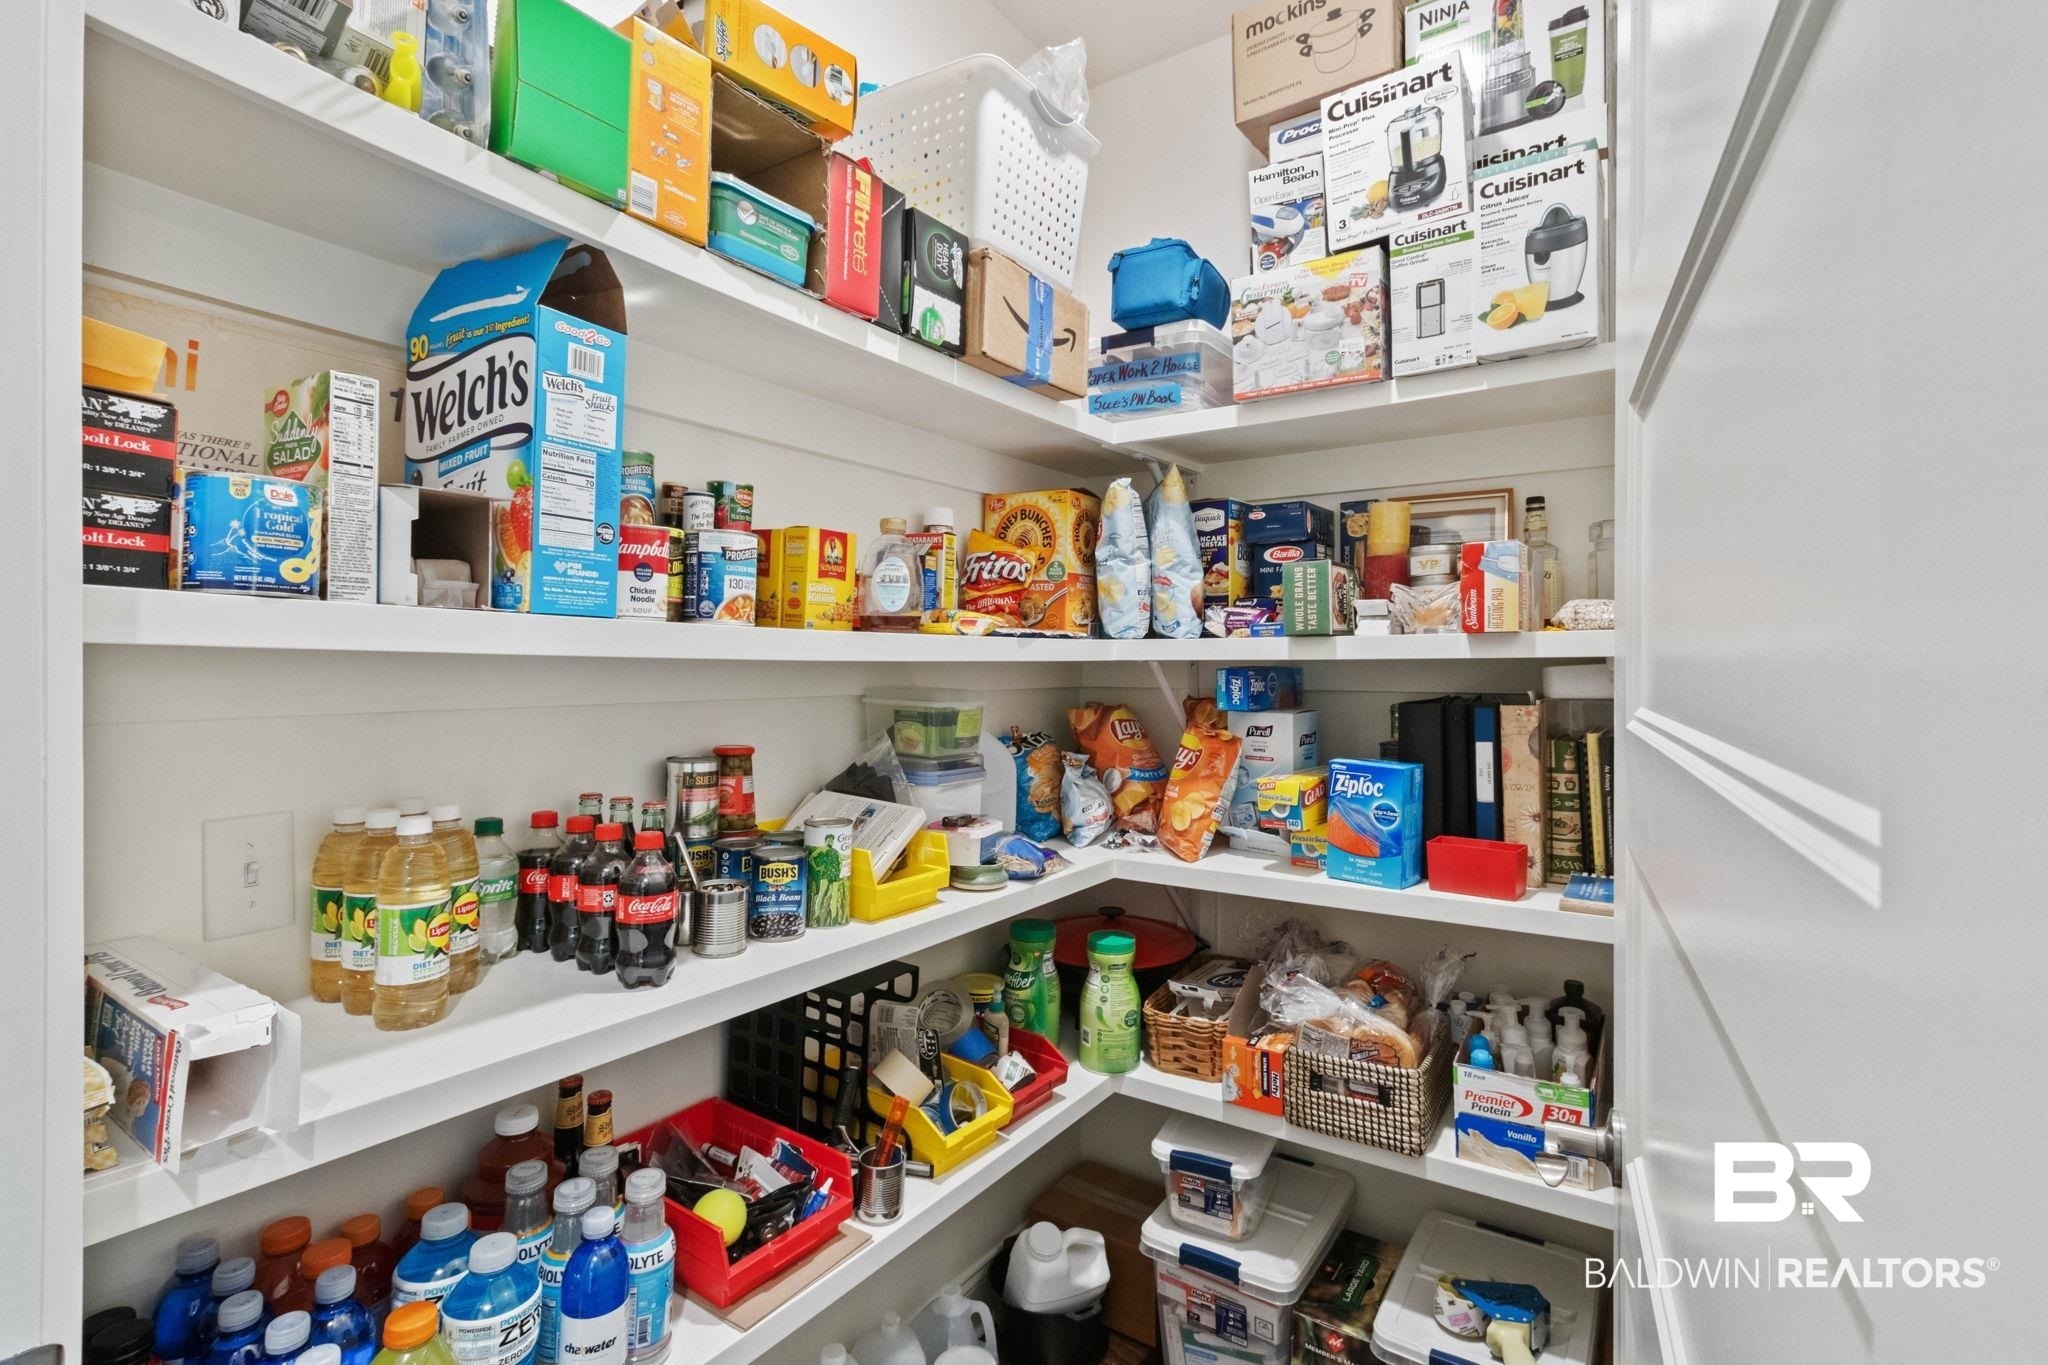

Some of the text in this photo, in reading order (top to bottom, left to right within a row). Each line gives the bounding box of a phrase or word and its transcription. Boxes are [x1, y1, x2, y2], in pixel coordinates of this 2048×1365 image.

[1419, 1, 1470, 31] NINJA
[715, 14, 730, 62] Swiffer
[1327, 62, 1453, 122] Cuisinart
[1328, 128, 1359, 141] Processor
[1253, 165, 1305, 184] Hamilton
[1282, 169, 1319, 185] Beach
[1480, 158, 1586, 200] Cuisinart
[1480, 194, 1530, 211] Citrus Juicer
[852, 168, 873, 274] Filtrete
[1338, 219, 1347, 230] 3
[1394, 219, 1467, 247] Cuisinart
[445, 327, 467, 350] Fruit
[473, 327, 485, 337] our
[495, 313, 531, 333] Ingredient!
[410, 334, 430, 363] 90
[1150, 360, 1160, 376] 2
[1394, 356, 1420, 366] Cuisinart
[545, 375, 584, 394] Welch's
[410, 350, 530, 444] Welch's
[590, 393, 612, 404] Fruit
[584, 399, 616, 413] Snacks
[101, 412, 159, 429] New Age Design
[103, 419, 152, 434] by DELANEY
[200, 432, 241, 450] THERE
[269, 413, 320, 453] Suddenly
[425, 414, 504, 454] FAMILY FARMER OWNED
[113, 434, 152, 453] Lock
[272, 446, 312, 466] SALAD
[439, 443, 490, 474] MIXED FRUIT
[542, 449, 596, 467] Nutrition Facts
[542, 473, 595, 488] Calories 70
[270, 489, 294, 500] Dole
[990, 500, 1004, 510] Post
[94, 511, 153, 524] New Age Design
[107, 519, 146, 529] DELANEY
[255, 507, 303, 524] Tropical
[1194, 513, 1222, 523] Bisquick
[265, 521, 295, 533] Gold
[1020, 508, 1052, 549] BUNCHES
[107, 532, 146, 548] Lock
[1271, 548, 1301, 559] Barilla
[960, 551, 1031, 585] Fritos
[727, 578, 744, 590] 130
[808, 584, 836, 594] Golden
[1295, 566, 1304, 598] GRAINS
[1307, 566, 1317, 600] BETTER
[629, 586, 657, 596] Chicken
[630, 592, 656, 604] Noodle
[808, 592, 837, 604] Raisins
[1492, 587, 1504, 601] PAD
[1295, 599, 1304, 631] WHOLE
[1308, 600, 1317, 631] TASTE
[1466, 588, 1477, 630] Sunbeam
[1492, 602, 1504, 630] HEATING
[1233, 678, 1241, 705] Ziploc
[1248, 727, 1272, 737] Purell
[1134, 769, 1157, 779] PARTY
[1258, 782, 1276, 791] GLAD
[1304, 782, 1326, 806] GLAD
[1334, 773, 1385, 799] Ziploc
[1279, 794, 1293, 802] Seal
[1287, 819, 1300, 828] 140
[760, 866, 797, 880] BUSH'S
[627, 894, 673, 914] Coca-Cola
[755, 894, 777, 903] Black
[457, 902, 477, 914] Lipton
[431, 922, 450, 938] Lipton
[352, 949, 369, 958] DIET
[412, 961, 432, 970] DIET
[1463, 1070, 1473, 1079] 18
[1272, 1071, 1280, 1098] Hefty
[1464, 1090, 1517, 1110] Premier
[1470, 1101, 1512, 1118] Protein
[1547, 1106, 1577, 1124] 30g
[1506, 1129, 1538, 1144] Vanilla
[1183, 1177, 1201, 1188] Hefty
[1355, 1259, 1371, 1279] YARD
[1191, 1288, 1211, 1302] Hefty
[1342, 1278, 1359, 1303] LARGE
[1304, 1342, 1344, 1363] MEMBER'S
